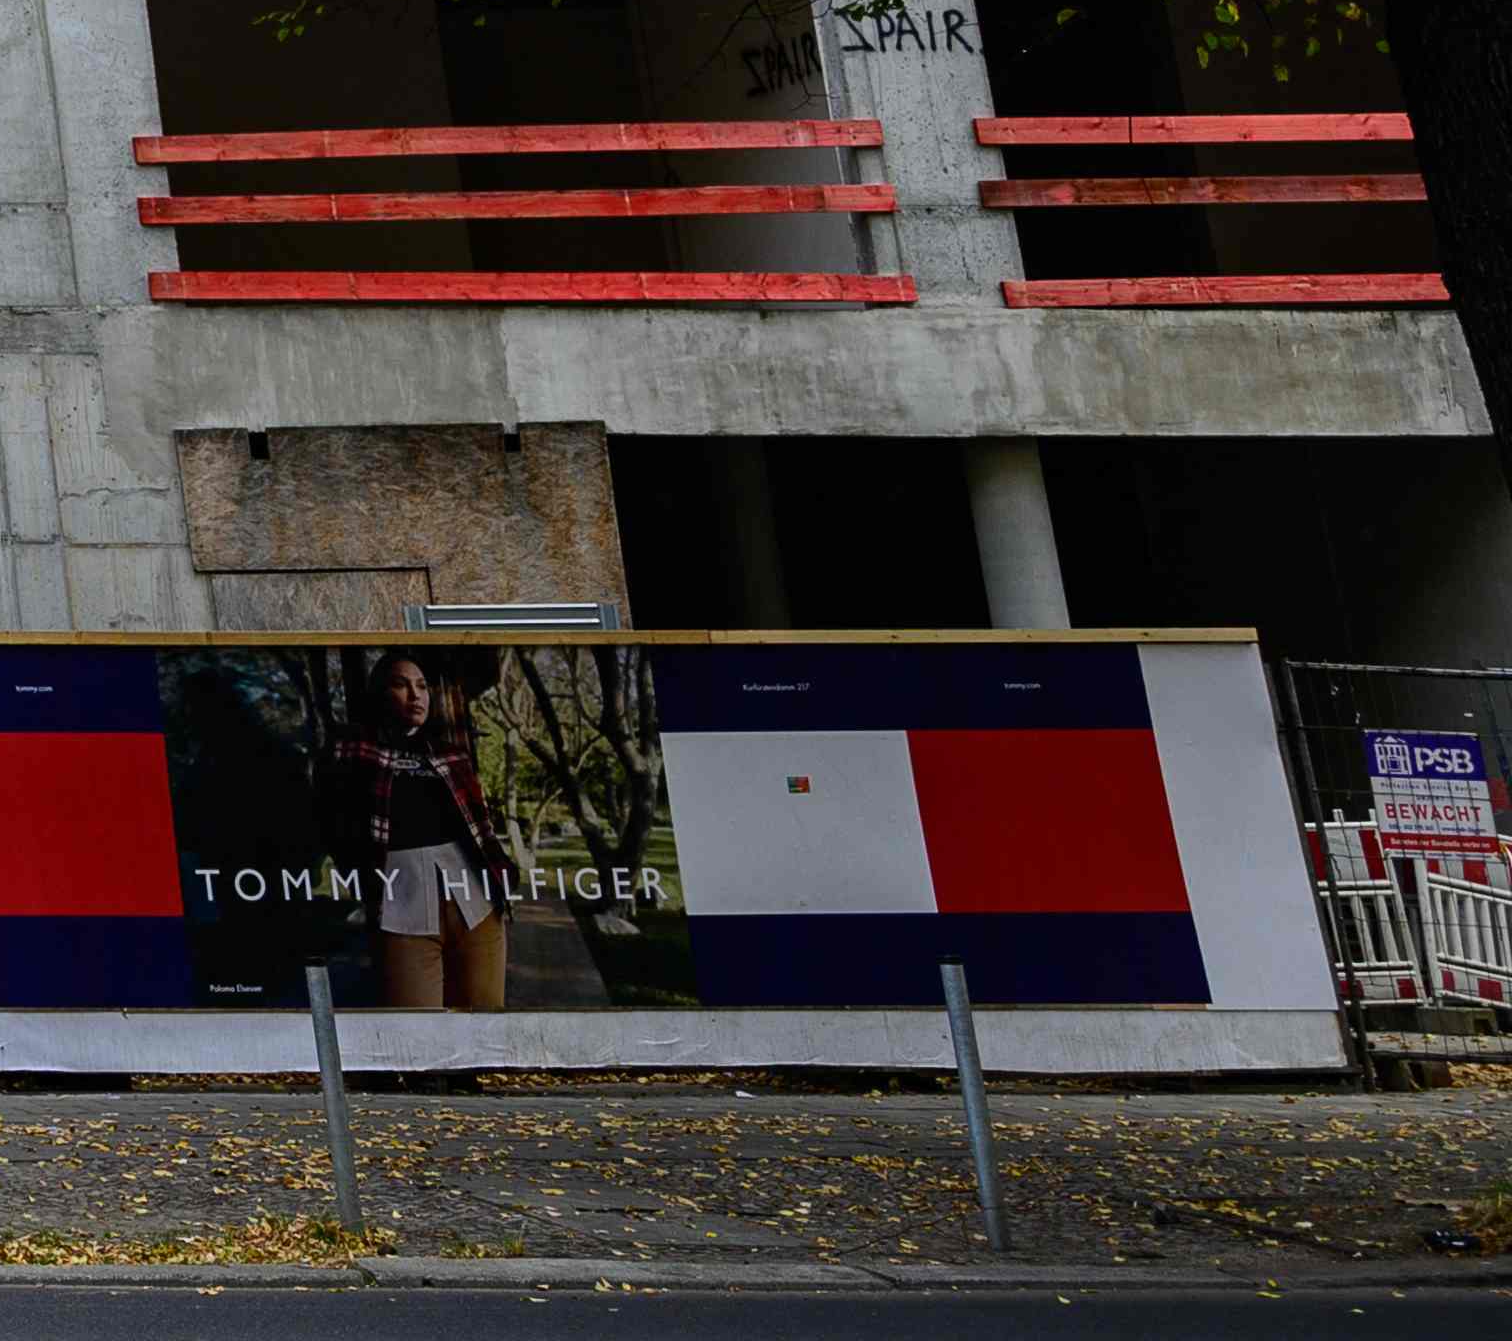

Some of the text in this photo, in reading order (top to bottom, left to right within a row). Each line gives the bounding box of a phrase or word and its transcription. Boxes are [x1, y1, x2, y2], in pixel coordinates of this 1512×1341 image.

[1414, 747, 1474, 773] PSB
[1384, 803, 1481, 822] BEWACHT
[195, 868, 670, 902] TOMMY HILFIGER
